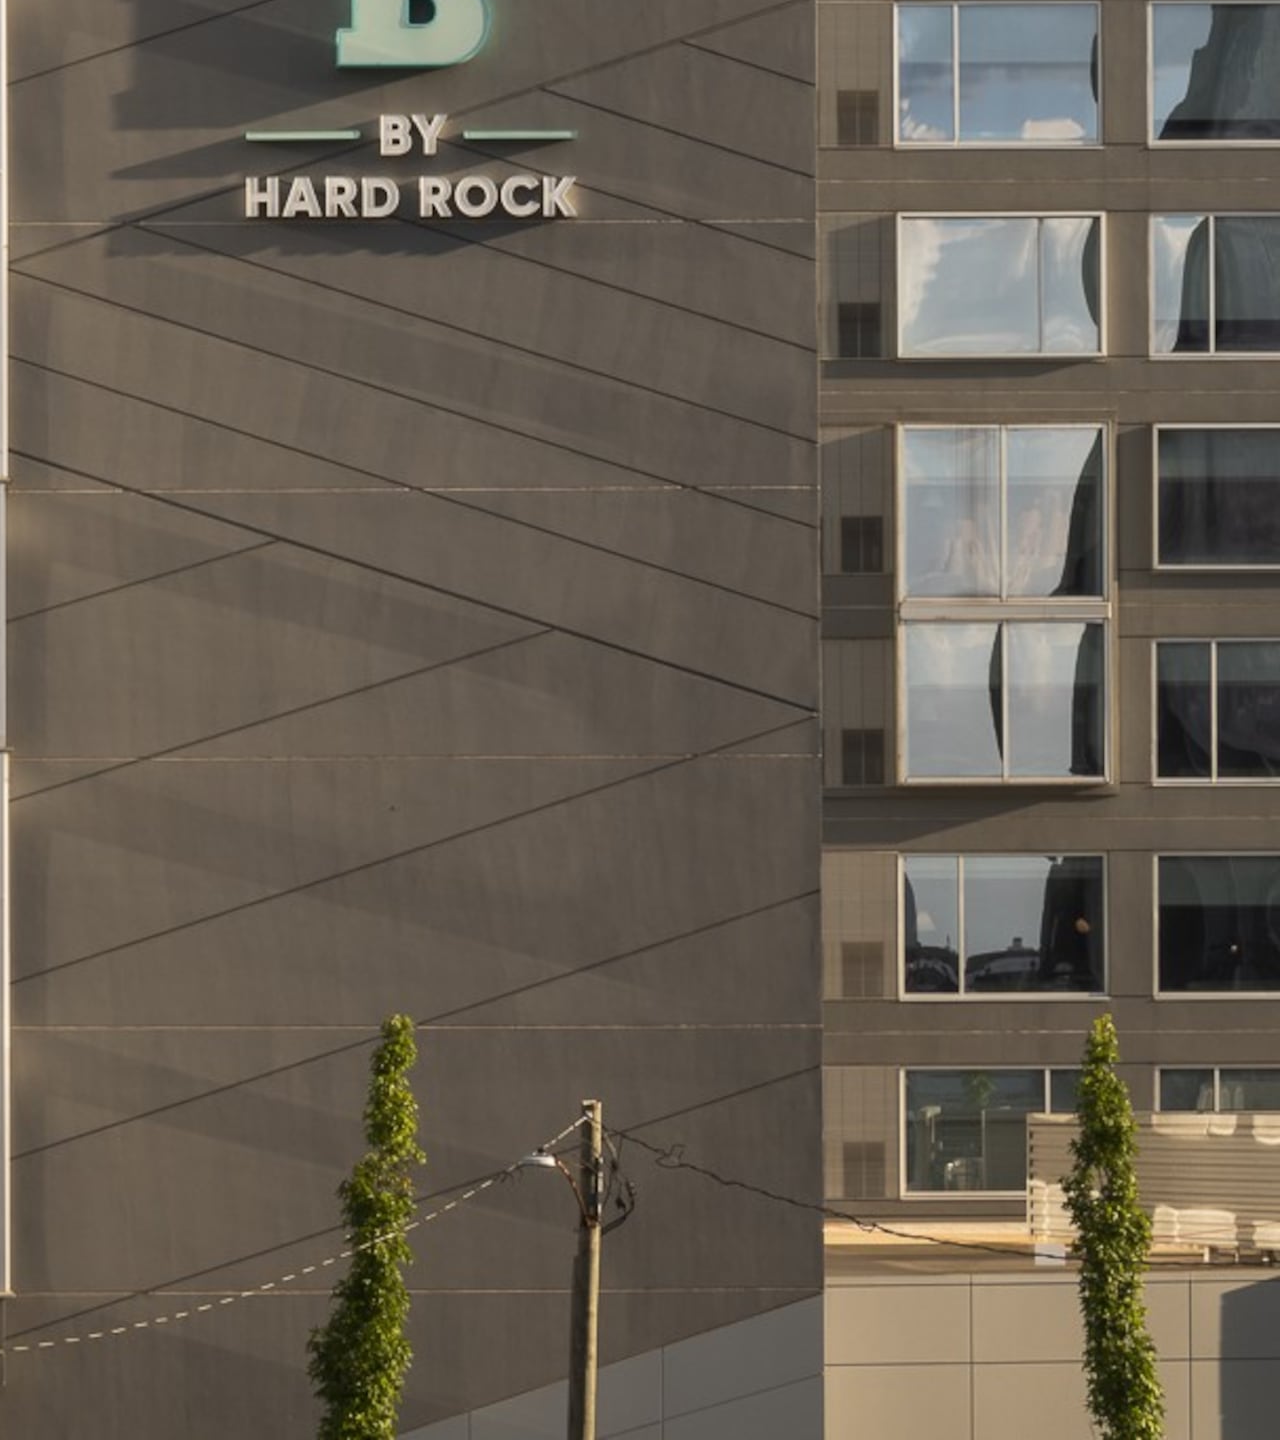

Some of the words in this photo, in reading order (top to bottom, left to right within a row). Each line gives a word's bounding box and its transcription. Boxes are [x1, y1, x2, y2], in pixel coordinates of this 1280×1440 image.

[379, 113, 448, 156] BY
[245, 175, 400, 218] HARD
[418, 175, 578, 218] ROCK
